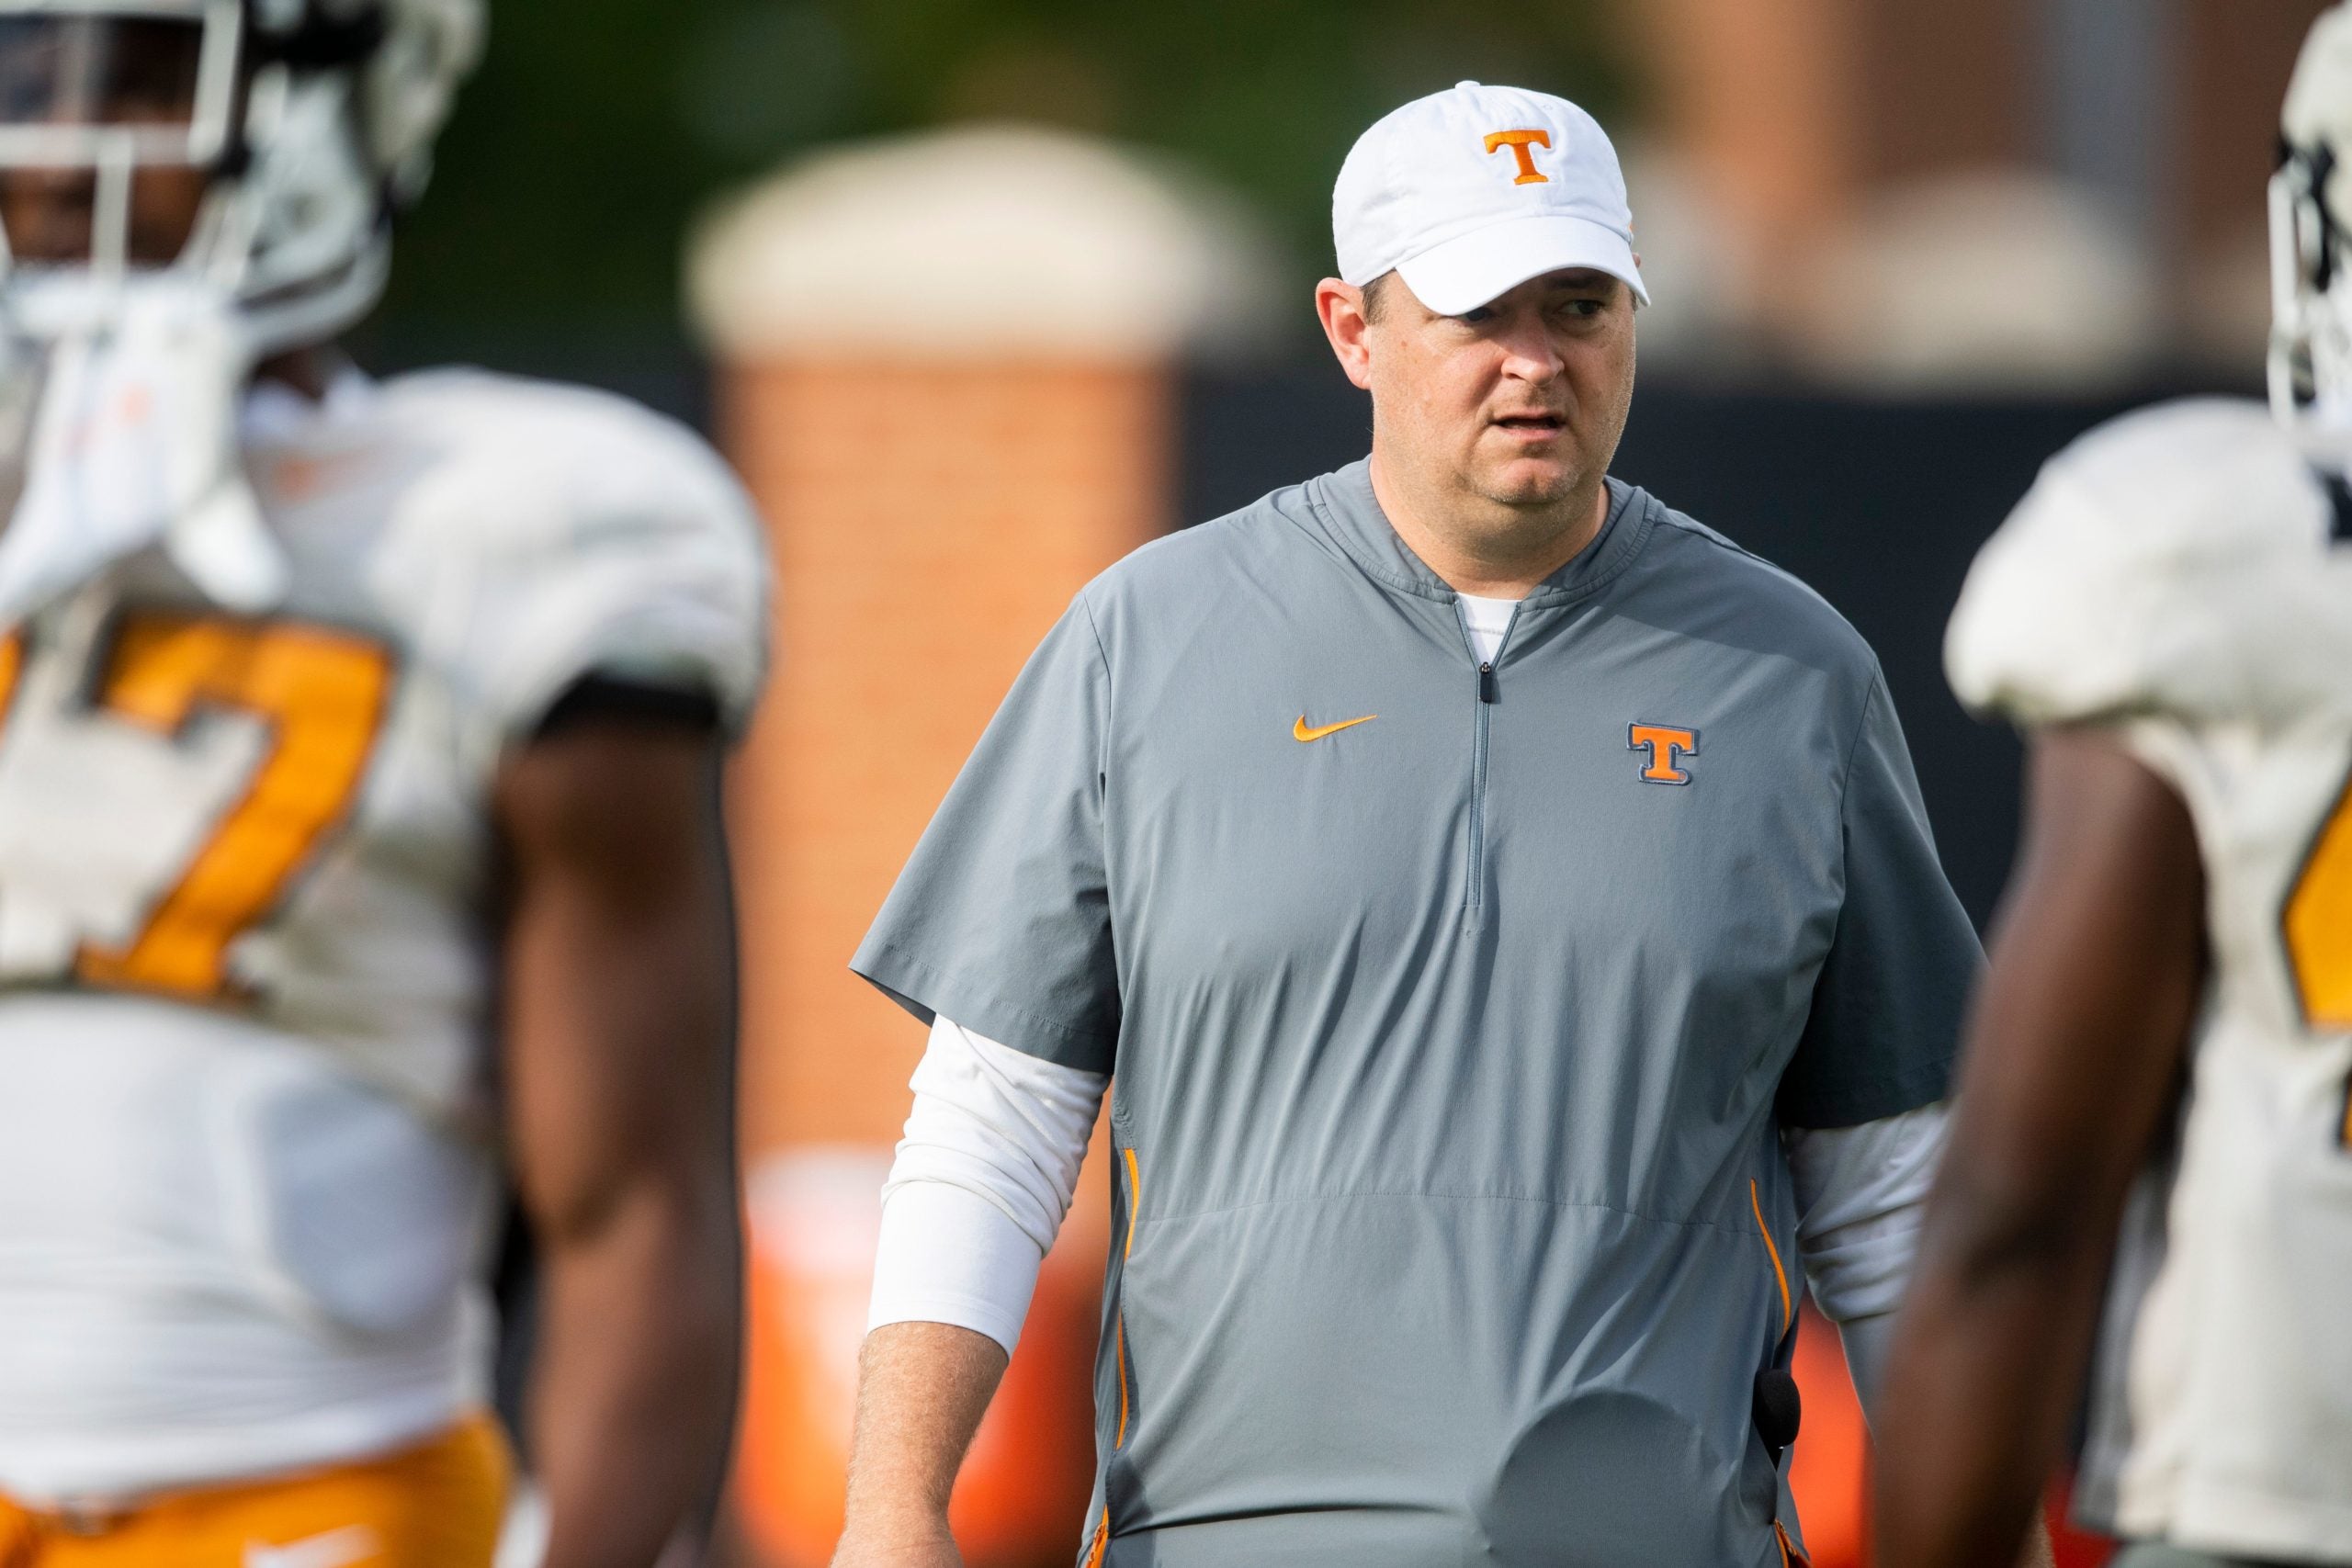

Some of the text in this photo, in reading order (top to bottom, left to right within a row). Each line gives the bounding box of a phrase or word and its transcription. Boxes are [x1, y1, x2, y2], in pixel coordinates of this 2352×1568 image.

[1483, 129, 1552, 186] T
[1627, 721, 1700, 785] T
[0, 608, 397, 1003] 7
